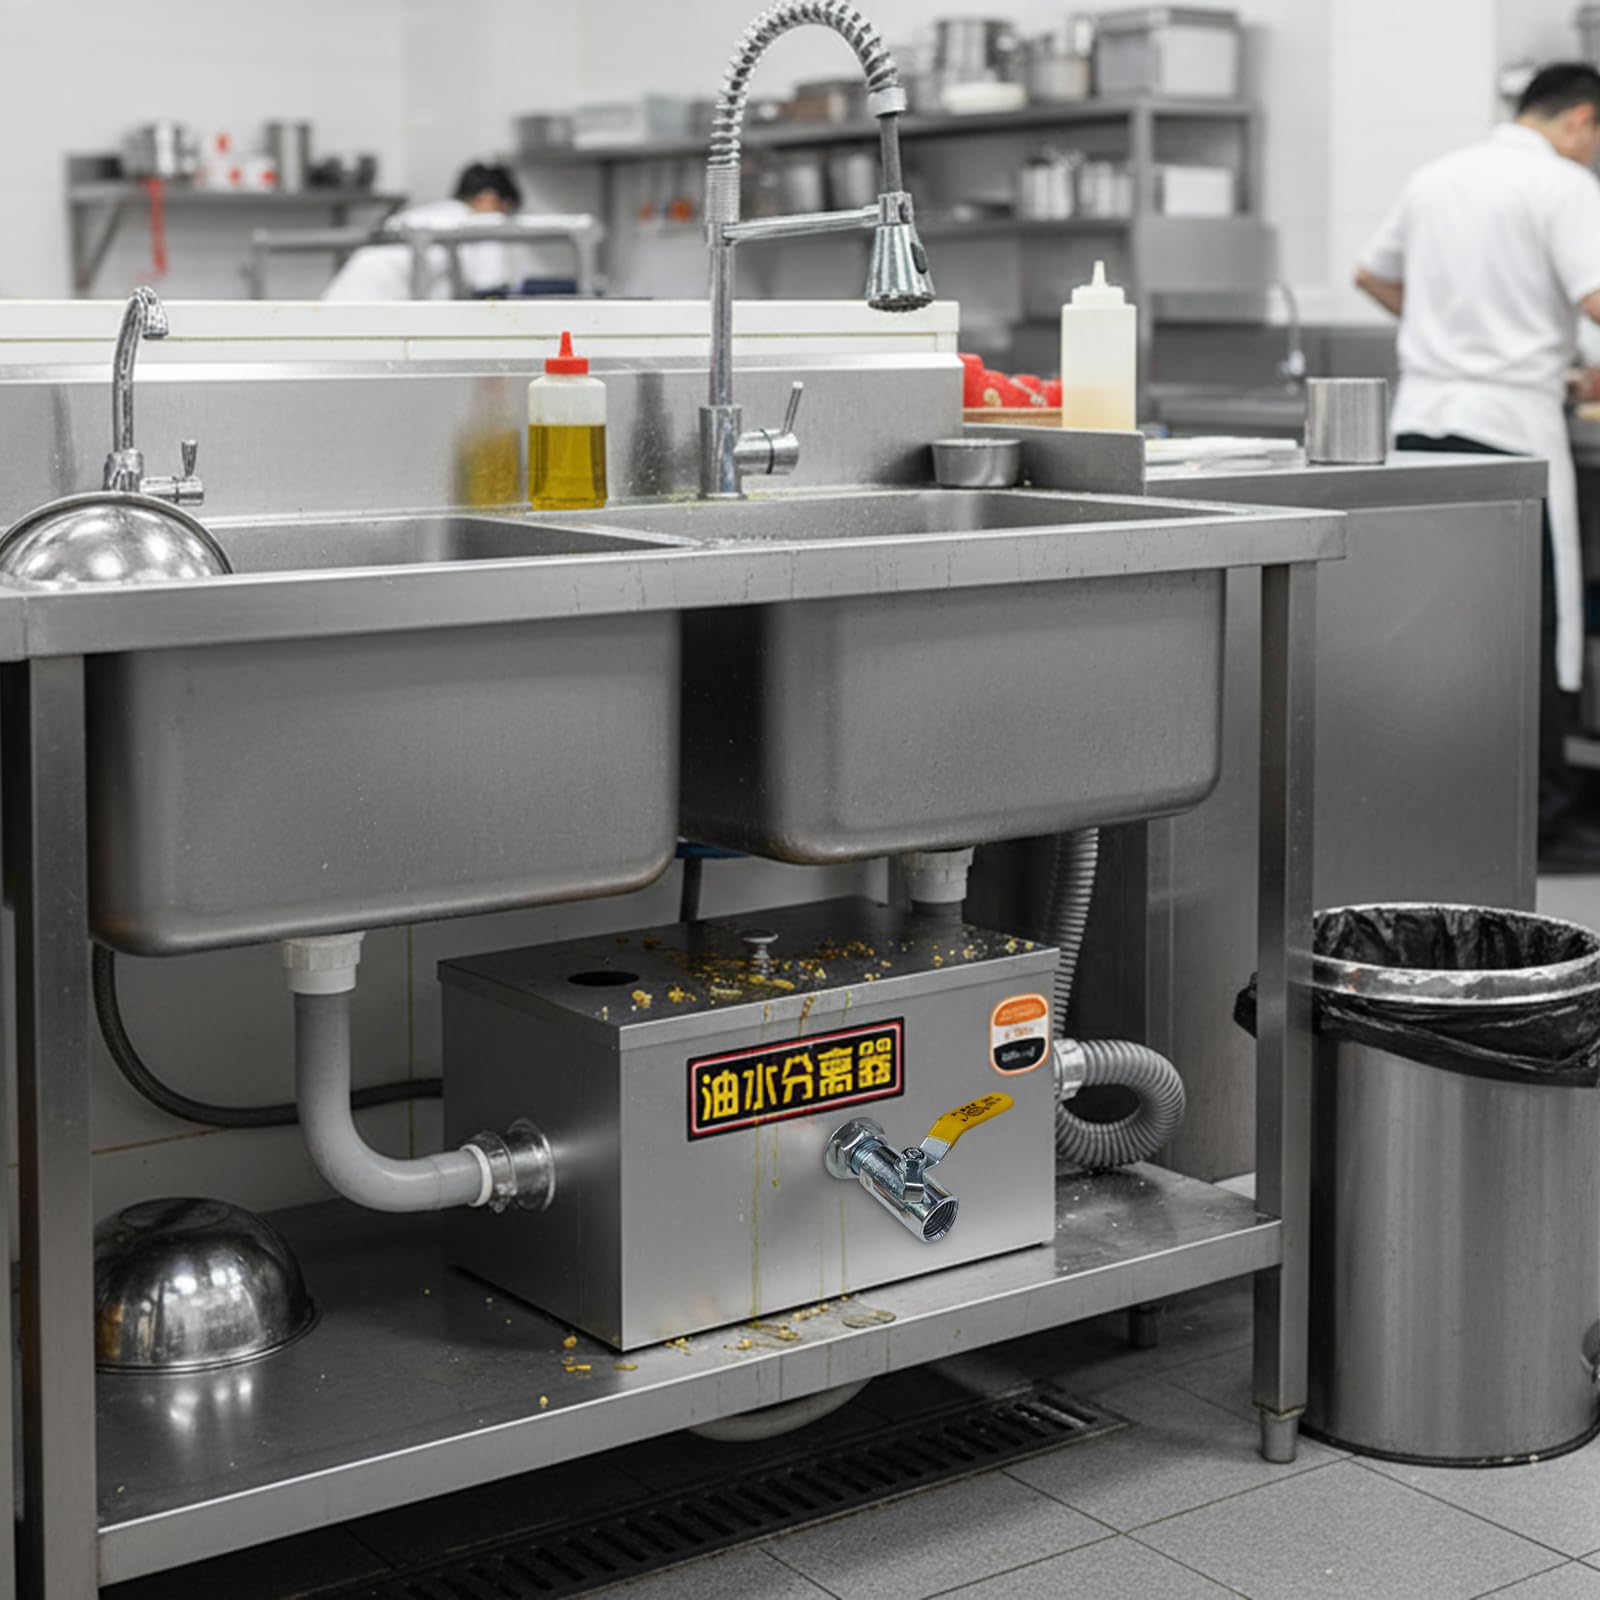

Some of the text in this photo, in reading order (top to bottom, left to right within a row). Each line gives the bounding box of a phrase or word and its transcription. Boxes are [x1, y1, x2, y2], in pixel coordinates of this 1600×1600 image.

[702, 1037, 892, 1121] 油水分离器
